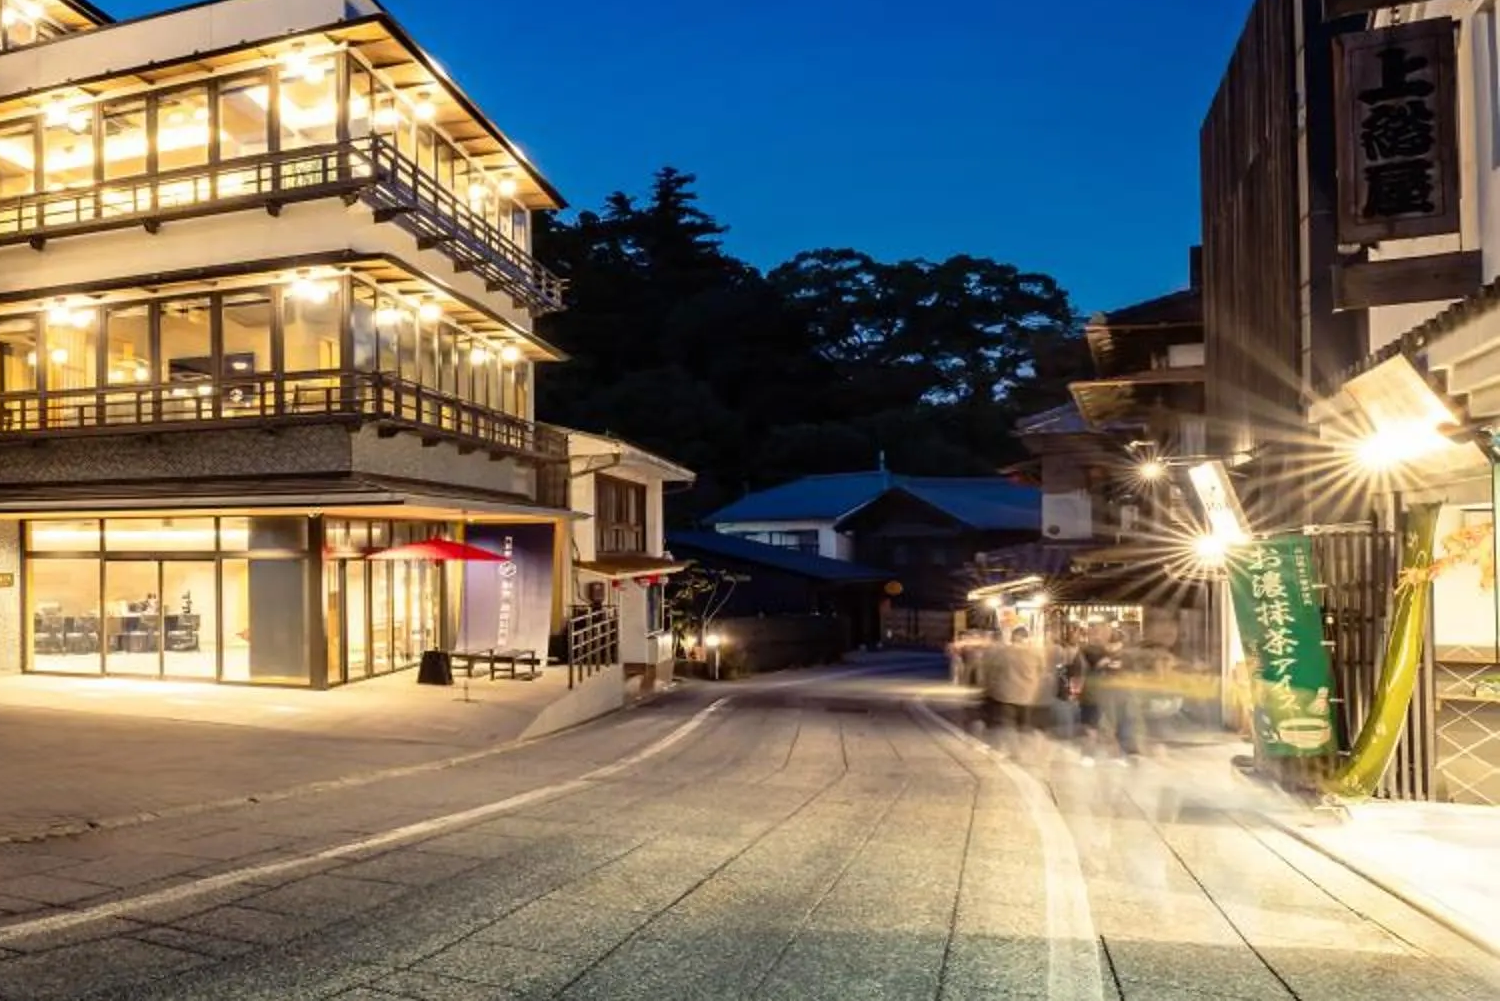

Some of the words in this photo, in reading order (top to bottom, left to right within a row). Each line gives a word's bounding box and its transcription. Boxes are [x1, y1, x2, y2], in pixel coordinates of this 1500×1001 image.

[1248, 546, 1301, 711] お濃抹茶アイス
